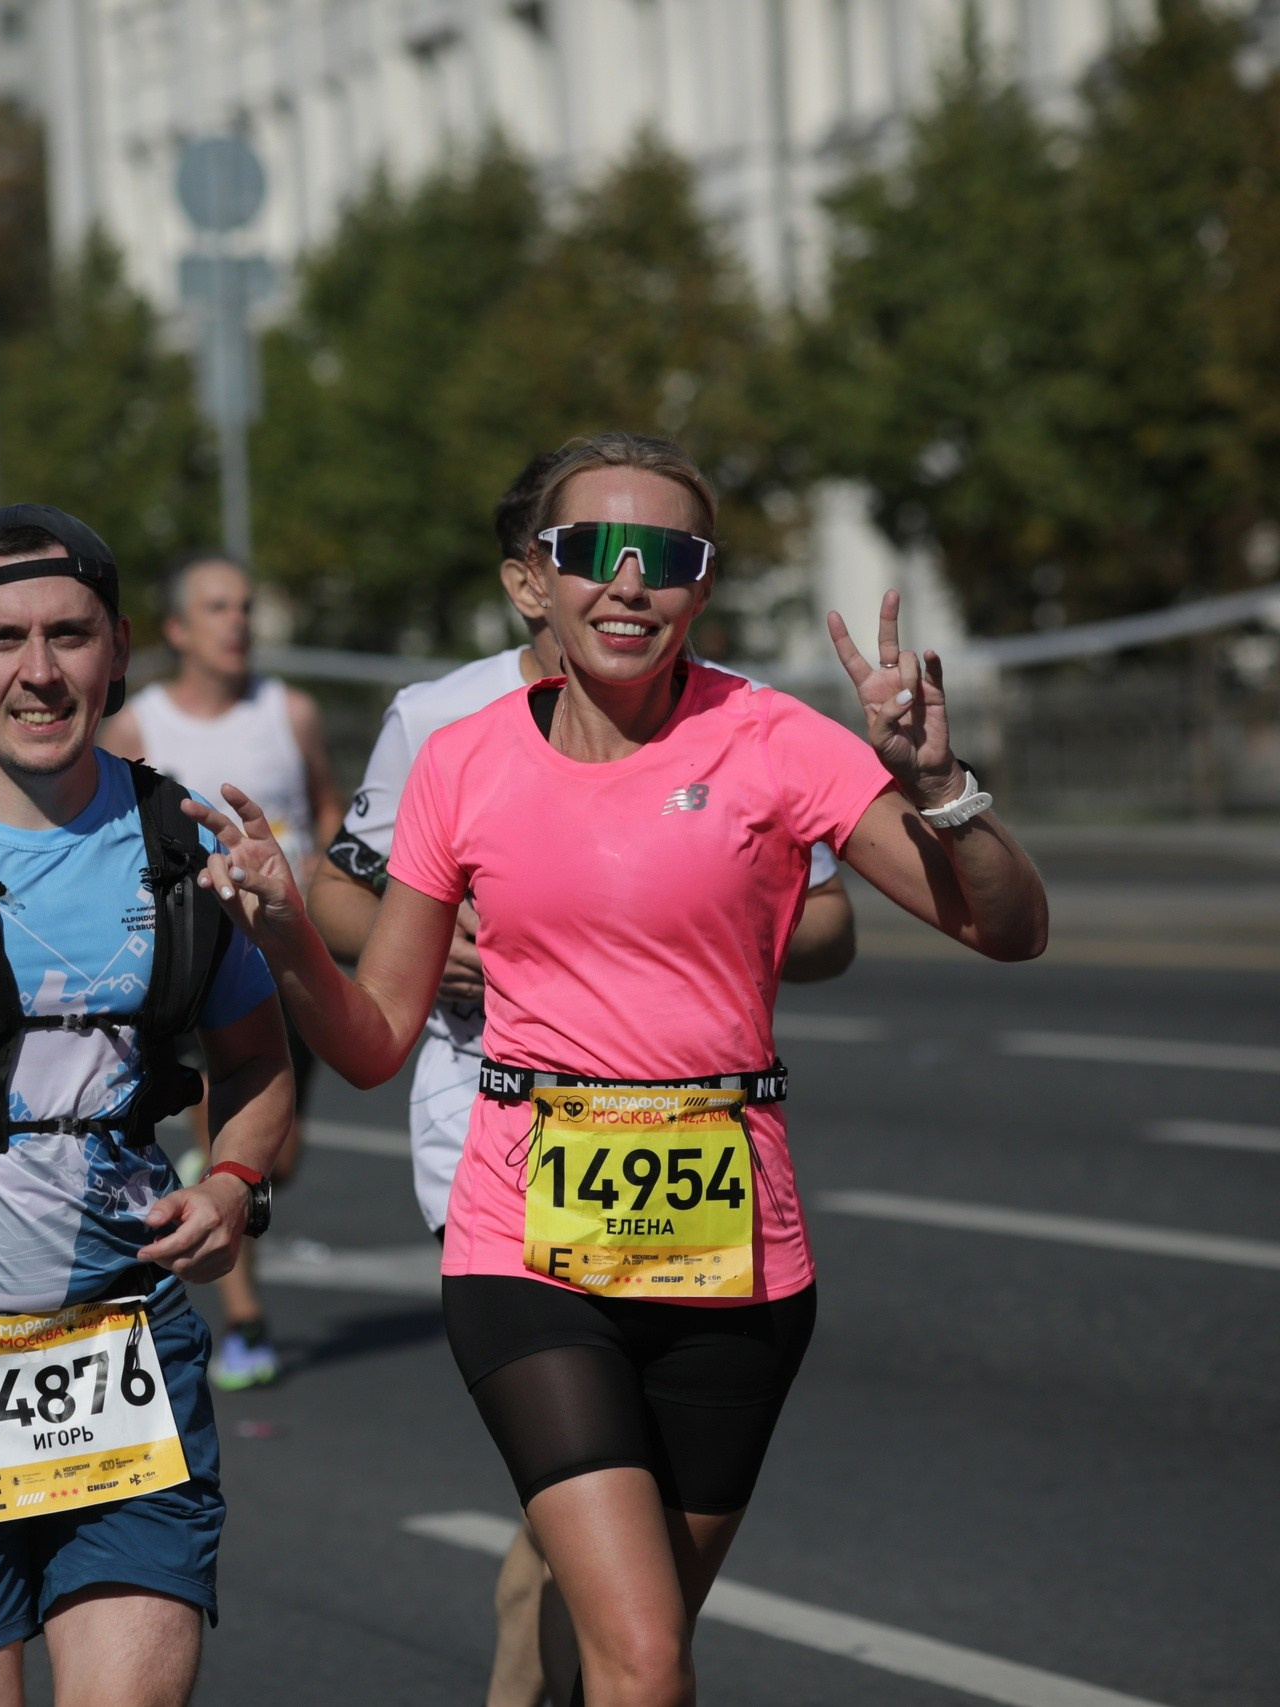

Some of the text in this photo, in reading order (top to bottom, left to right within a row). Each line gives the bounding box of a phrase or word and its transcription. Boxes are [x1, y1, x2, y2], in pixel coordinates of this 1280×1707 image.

[592, 1096, 679, 1109] МАРАФОН
[592, 1111, 664, 1124] МОСКВА
[541, 1146, 746, 1211] 14954
[606, 1218, 674, 1236] ЕЛЕНА
[548, 1247, 573, 1282] E
[0, 1325, 65, 1349] МОСКВА
[33, 1426, 94, 1450] ИГОРЬ
[87, 1480, 119, 1492] СИБУР
